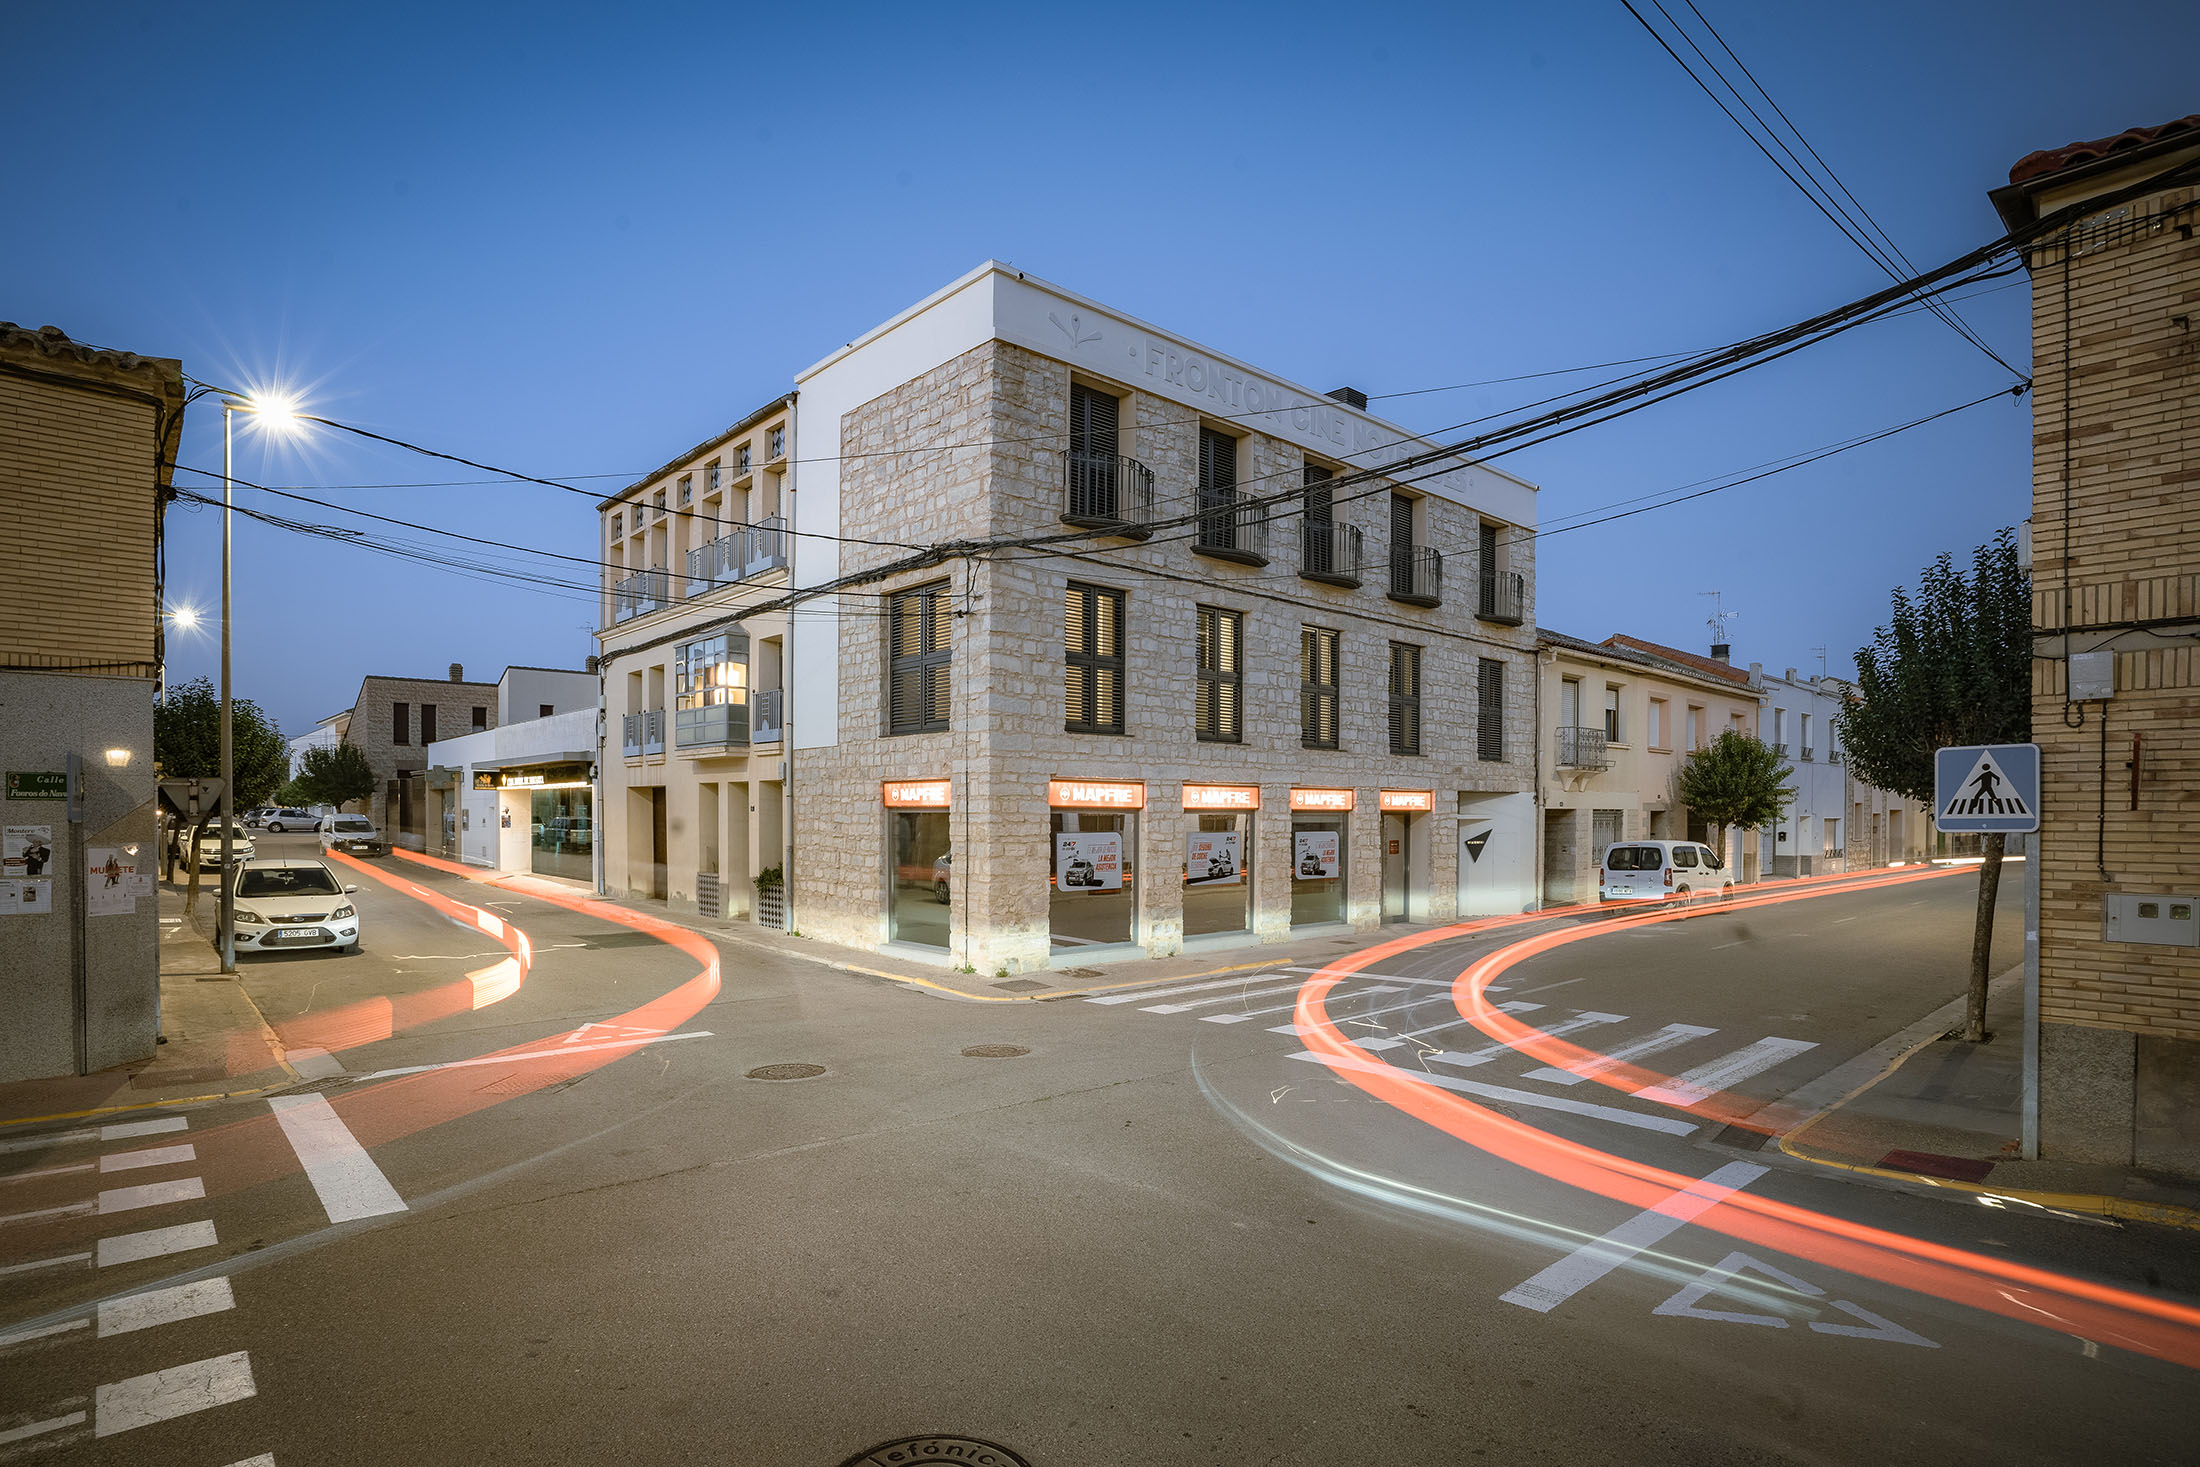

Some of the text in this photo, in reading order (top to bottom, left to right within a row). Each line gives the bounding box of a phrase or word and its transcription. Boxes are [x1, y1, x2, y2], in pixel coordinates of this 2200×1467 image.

[1144, 335, 1281, 424] FRONTON
[1290, 399, 1346, 447] CINE
[36, 775, 65, 784] Calle
[900, 787, 945, 801] MAPFRE
[1072, 787, 1133, 803] MAPFRE
[1201, 790, 1251, 804] MAPFRE
[1304, 793, 1346, 806] MAPFRE
[1391, 795, 1426, 807] MAPFRE
[867, 1440, 1006, 1467] lefónic
